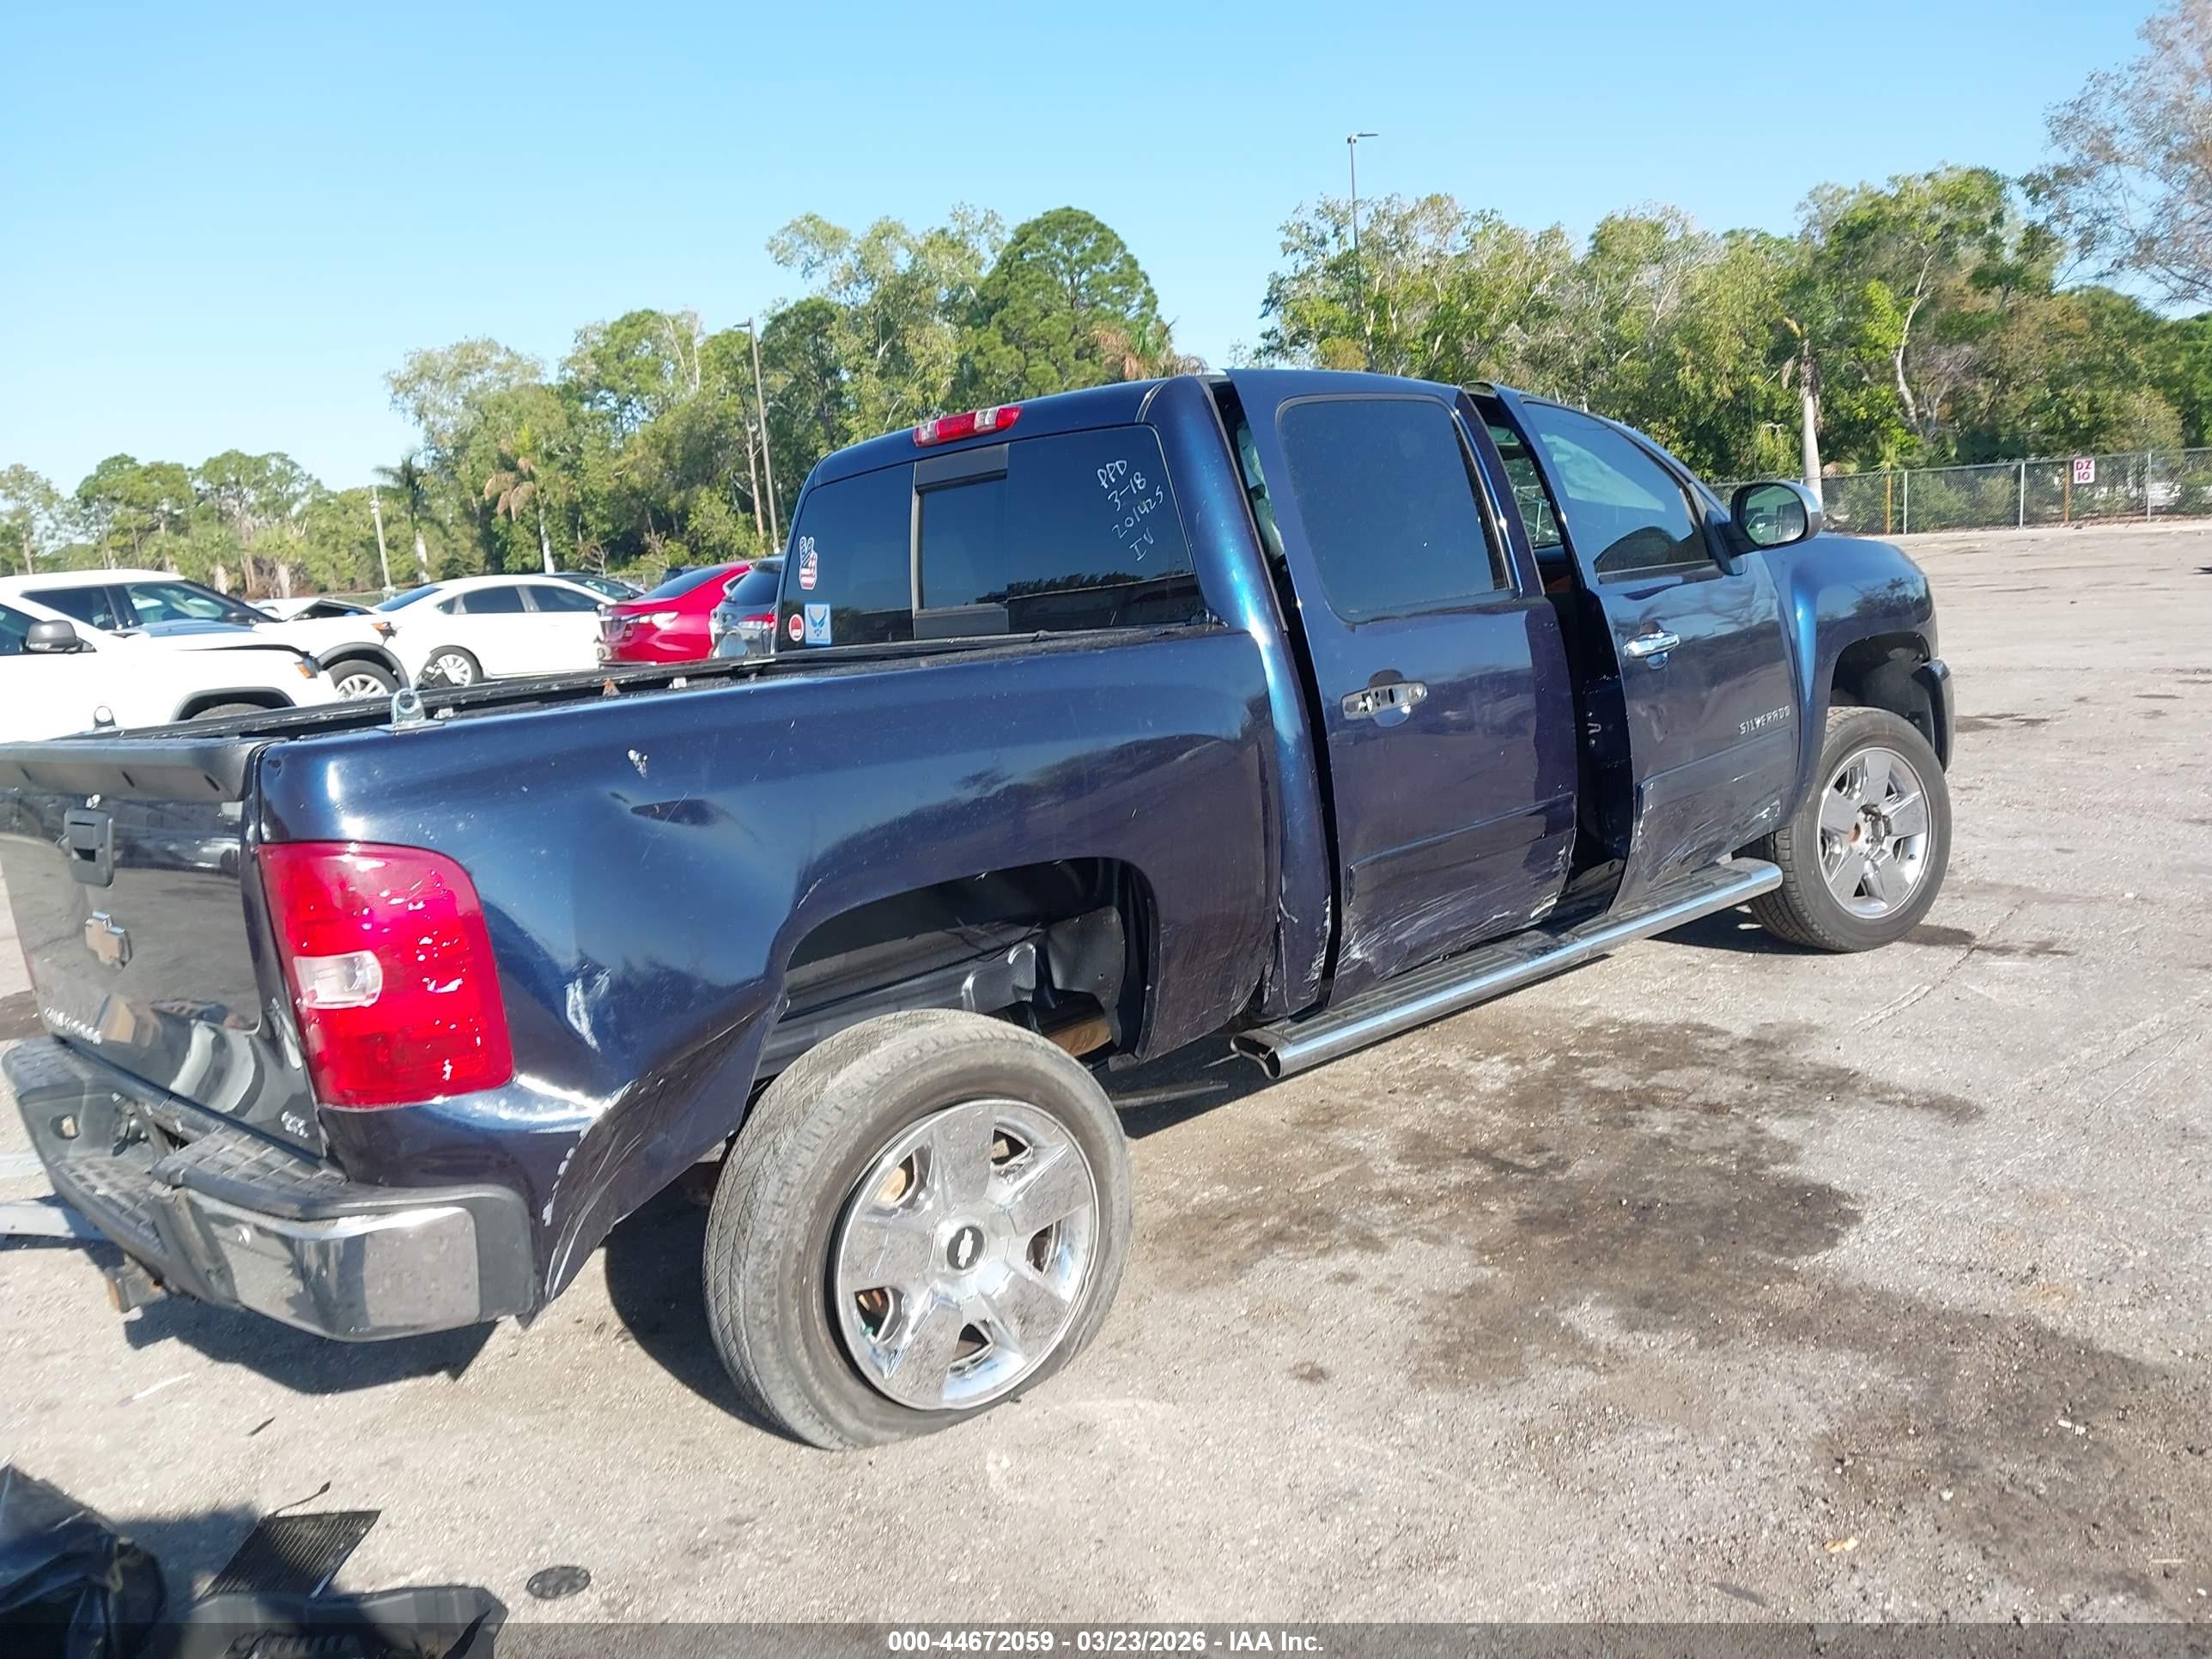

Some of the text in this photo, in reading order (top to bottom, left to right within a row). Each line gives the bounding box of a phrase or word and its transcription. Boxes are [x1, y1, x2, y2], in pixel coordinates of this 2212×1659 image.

[2075, 459, 2093, 471] DZ
[1108, 471, 1146, 512] 3-18
[1112, 484, 1164, 539] 201425
[1739, 705, 1790, 736] SILVERADO
